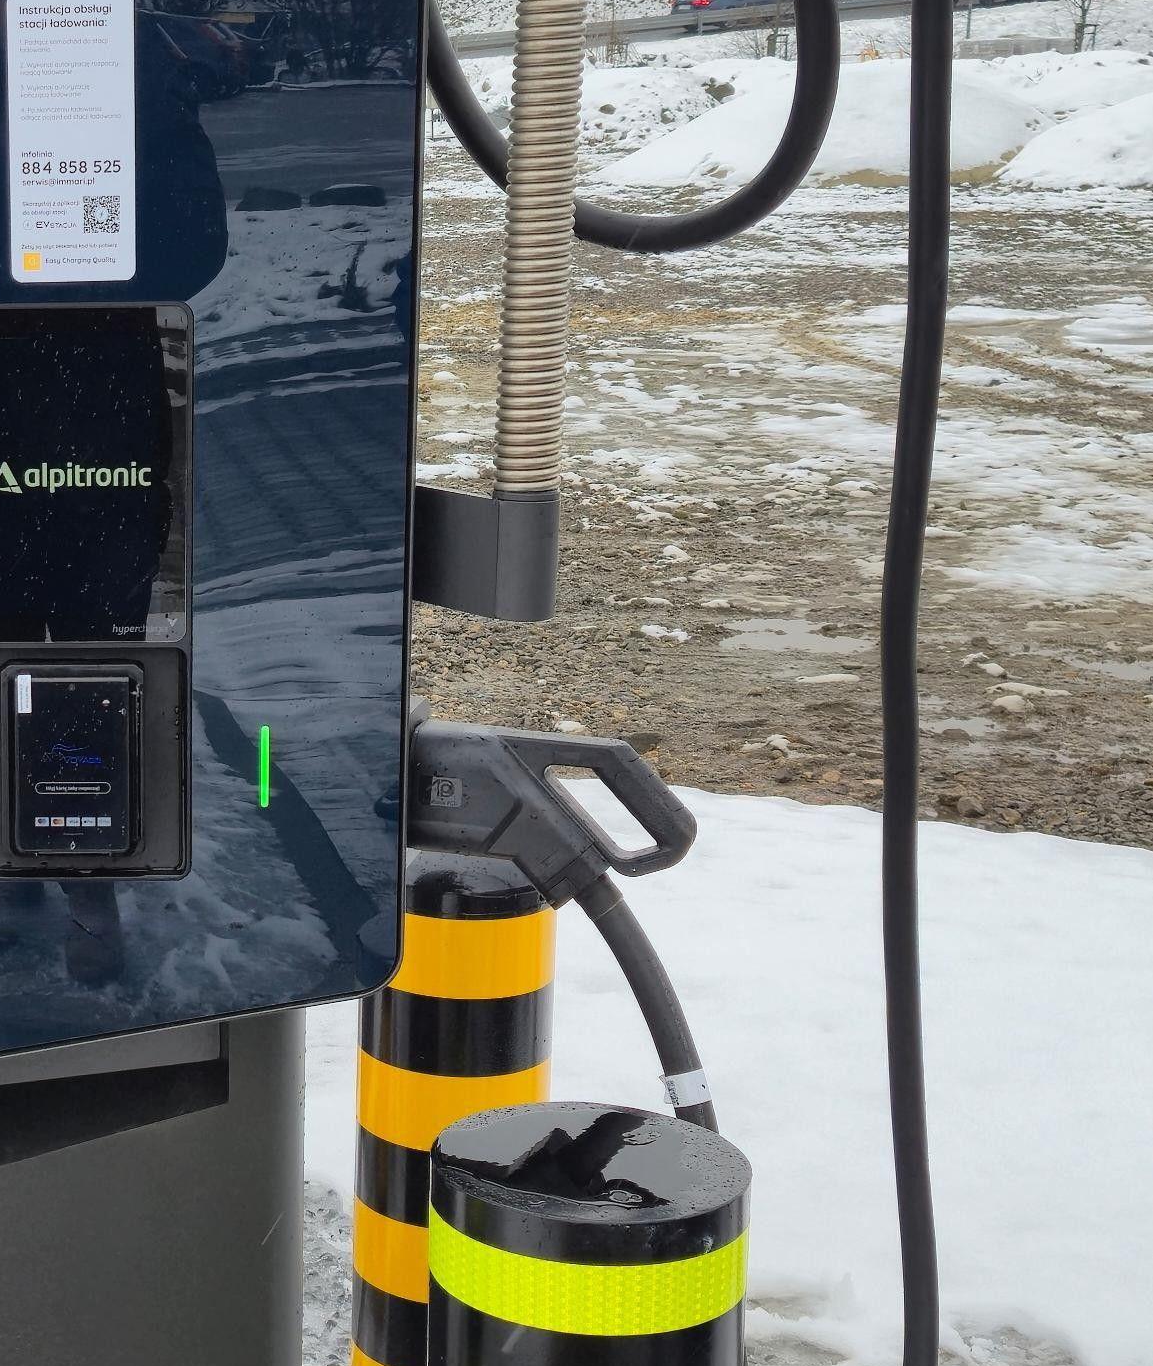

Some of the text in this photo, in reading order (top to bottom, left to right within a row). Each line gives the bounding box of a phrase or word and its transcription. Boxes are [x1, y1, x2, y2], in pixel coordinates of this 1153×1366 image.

[19, 4, 112, 16] Instrukcja obsługi
[19, 17, 108, 30] stacji ładowania:
[22, 160, 121, 175] 884 858 525
[24, 461, 152, 494] alpitronic
